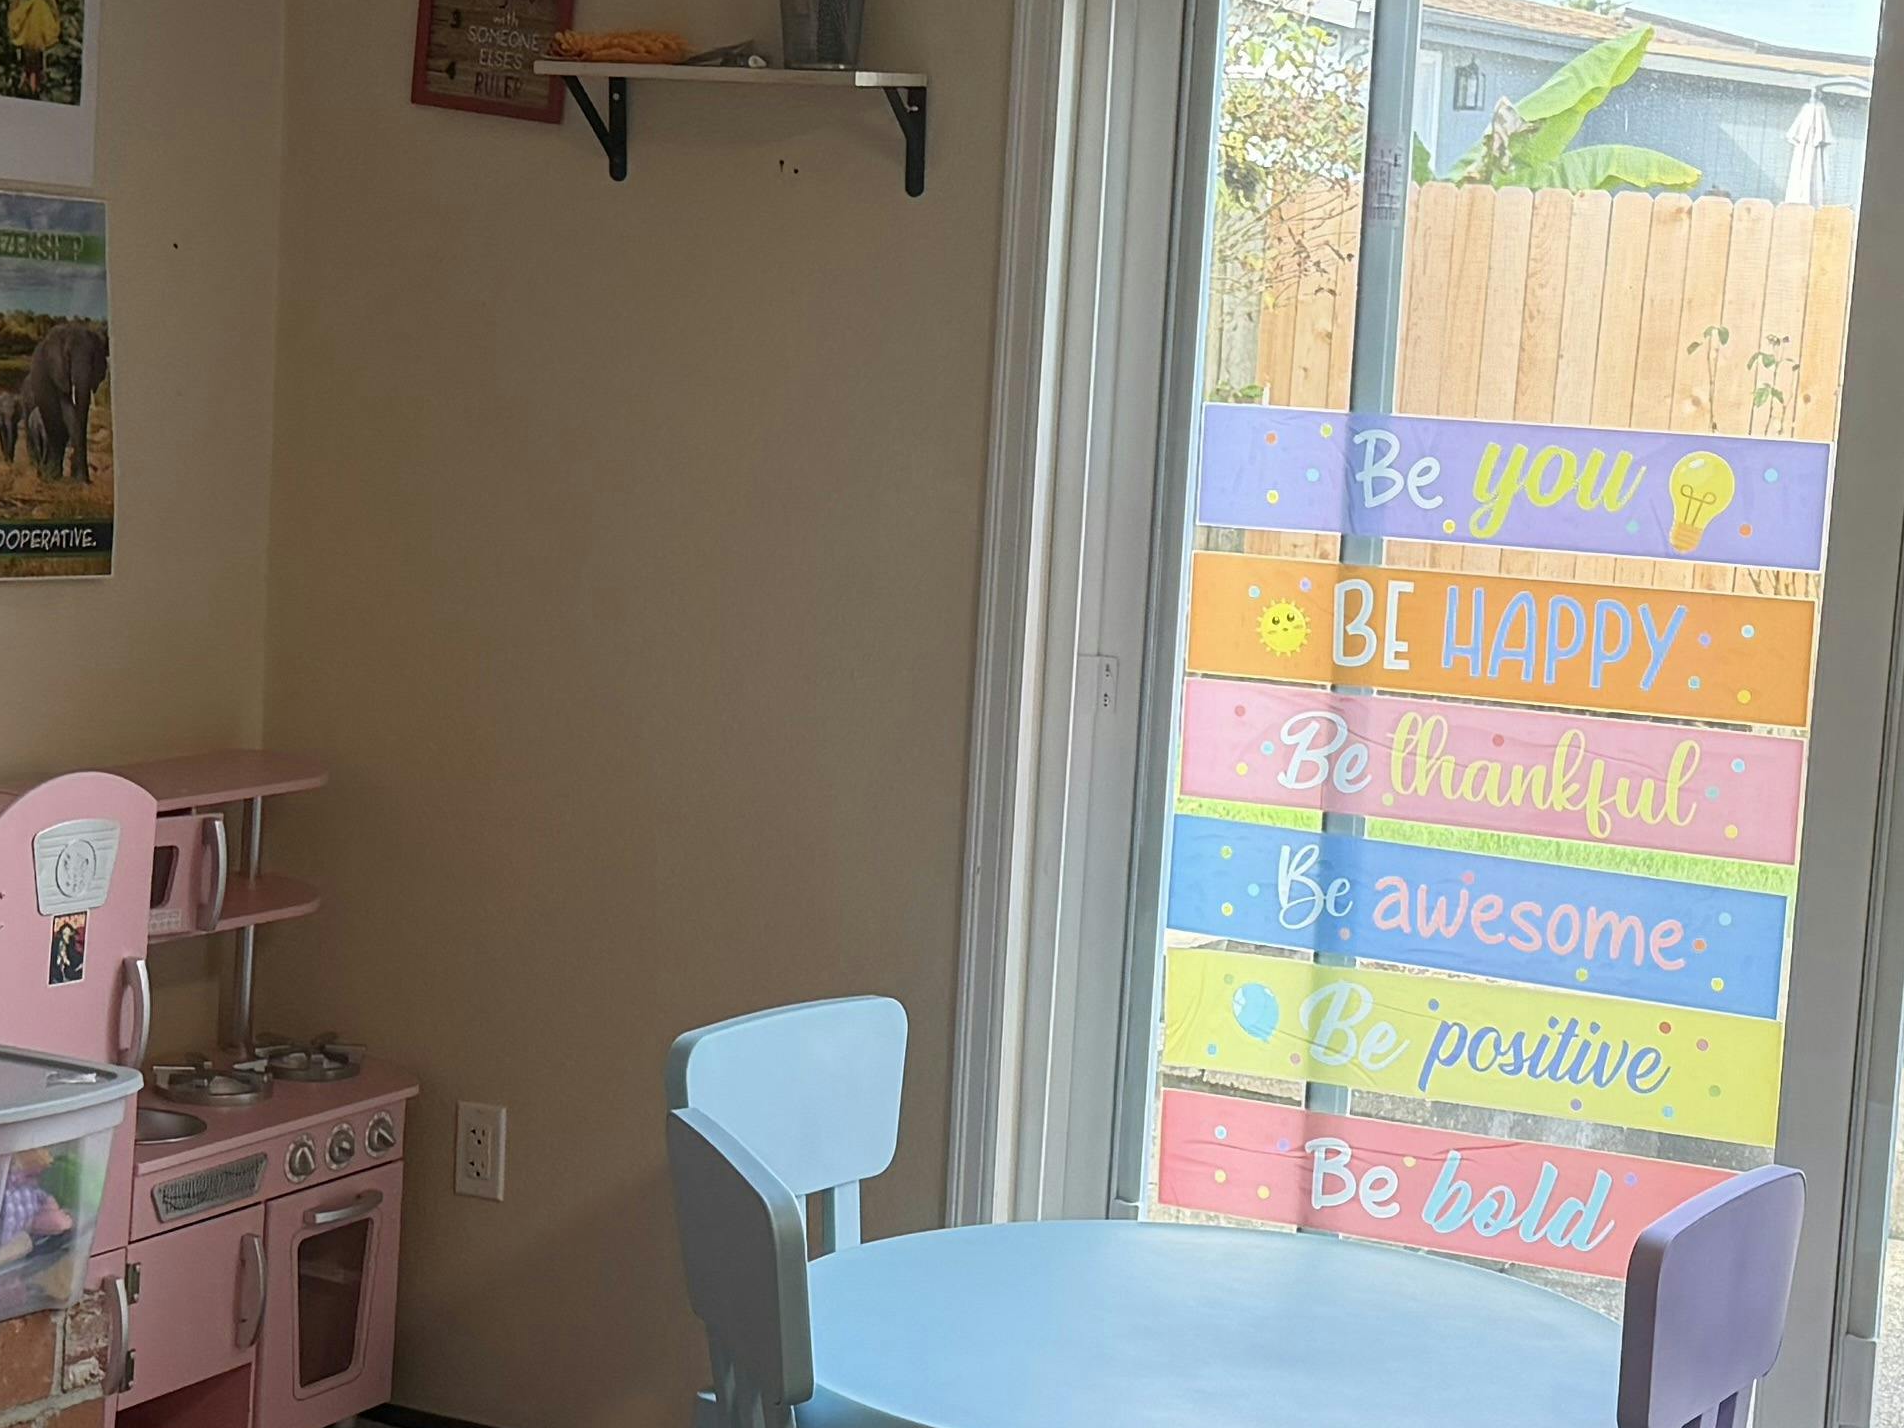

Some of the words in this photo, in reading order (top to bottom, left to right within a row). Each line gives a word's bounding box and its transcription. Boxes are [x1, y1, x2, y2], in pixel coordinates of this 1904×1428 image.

[467, 25, 541, 52] SOMEONE
[1353, 427, 1445, 510] Be
[1469, 439, 1647, 541] you
[1333, 577, 1415, 672] BE
[1442, 583, 1688, 692] HAPPY
[1276, 710, 1372, 794] Be
[1387, 710, 1703, 839] thankful
[1276, 843, 1355, 929] Be
[1372, 873, 1688, 972] awesome
[1298, 979, 1411, 1067] Be
[1416, 1014, 1672, 1095] positive
[1303, 1135, 1402, 1221] Be
[1420, 1148, 1617, 1253] bold
